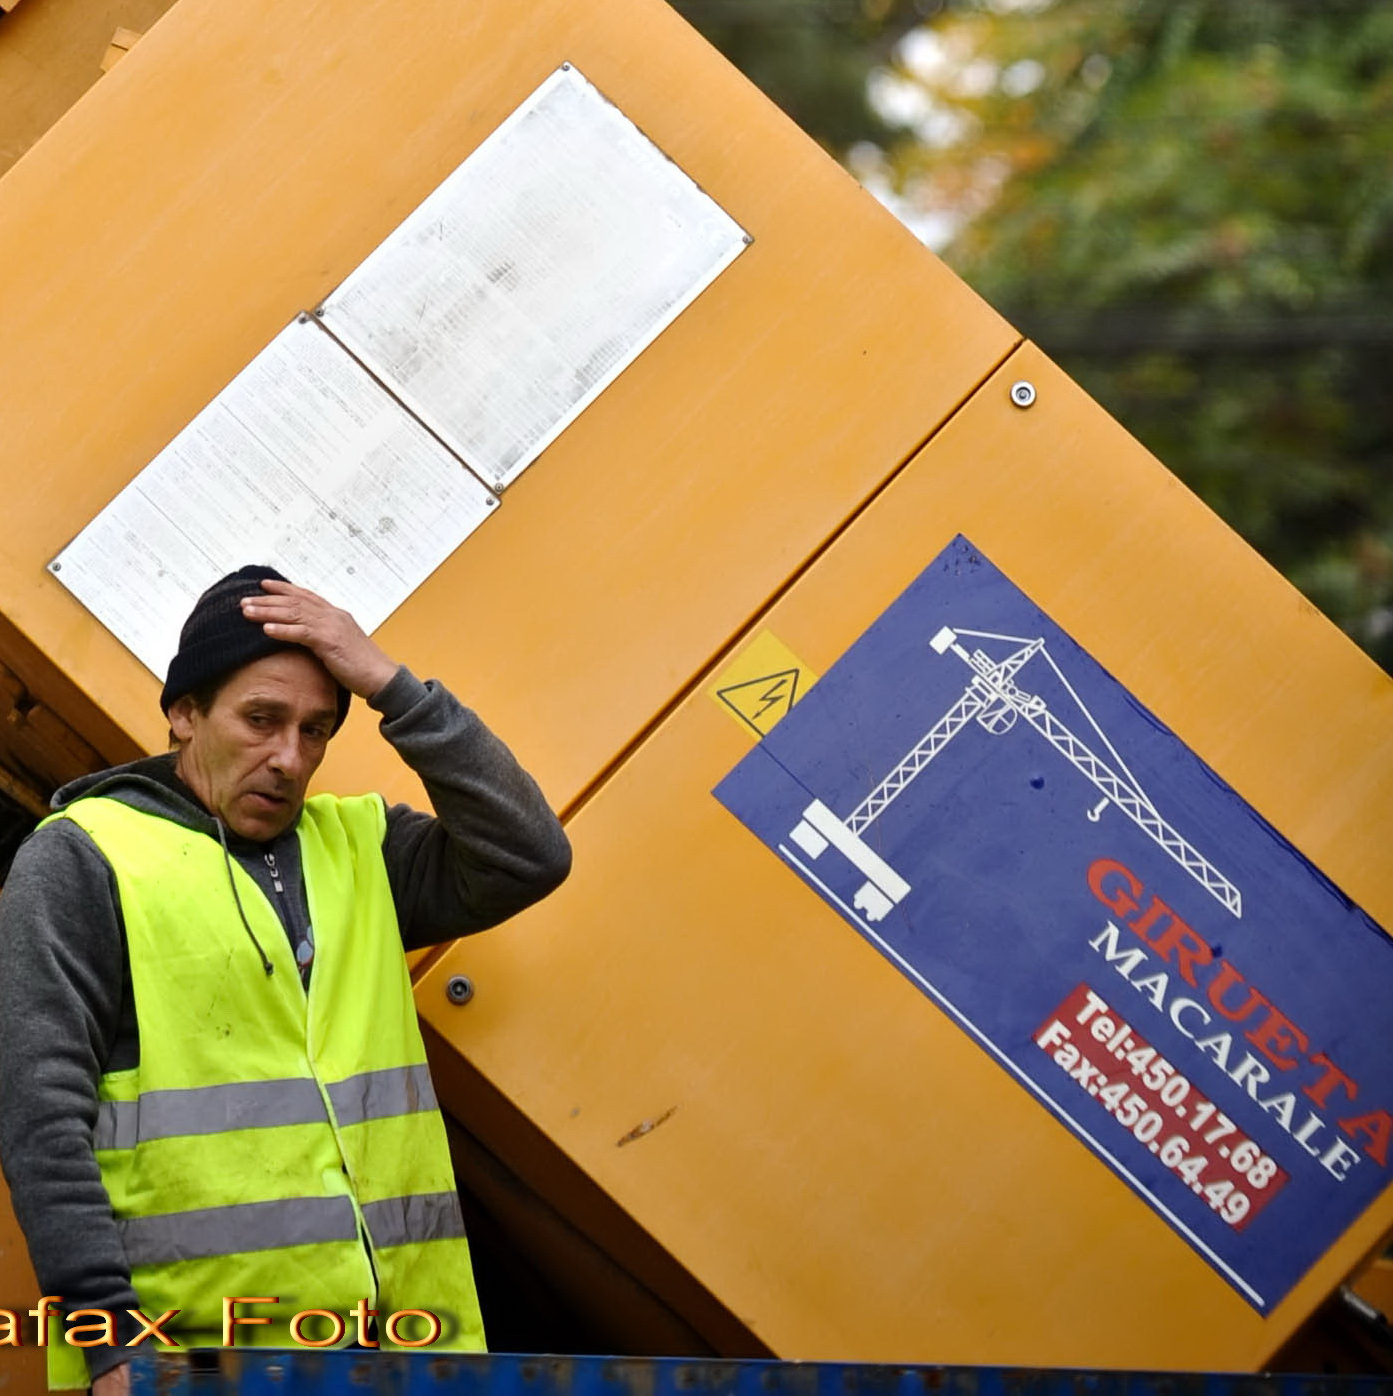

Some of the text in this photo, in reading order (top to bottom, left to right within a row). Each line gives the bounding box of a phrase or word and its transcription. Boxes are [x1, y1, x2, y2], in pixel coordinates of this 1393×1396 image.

[1036, 1019, 1251, 1225] Fax:450.64.49
[1075, 990, 1278, 1190] Tel:450.17.68
[1087, 858, 1393, 1166] GIRUETA
[1088, 920, 1361, 1182] MACARALE
